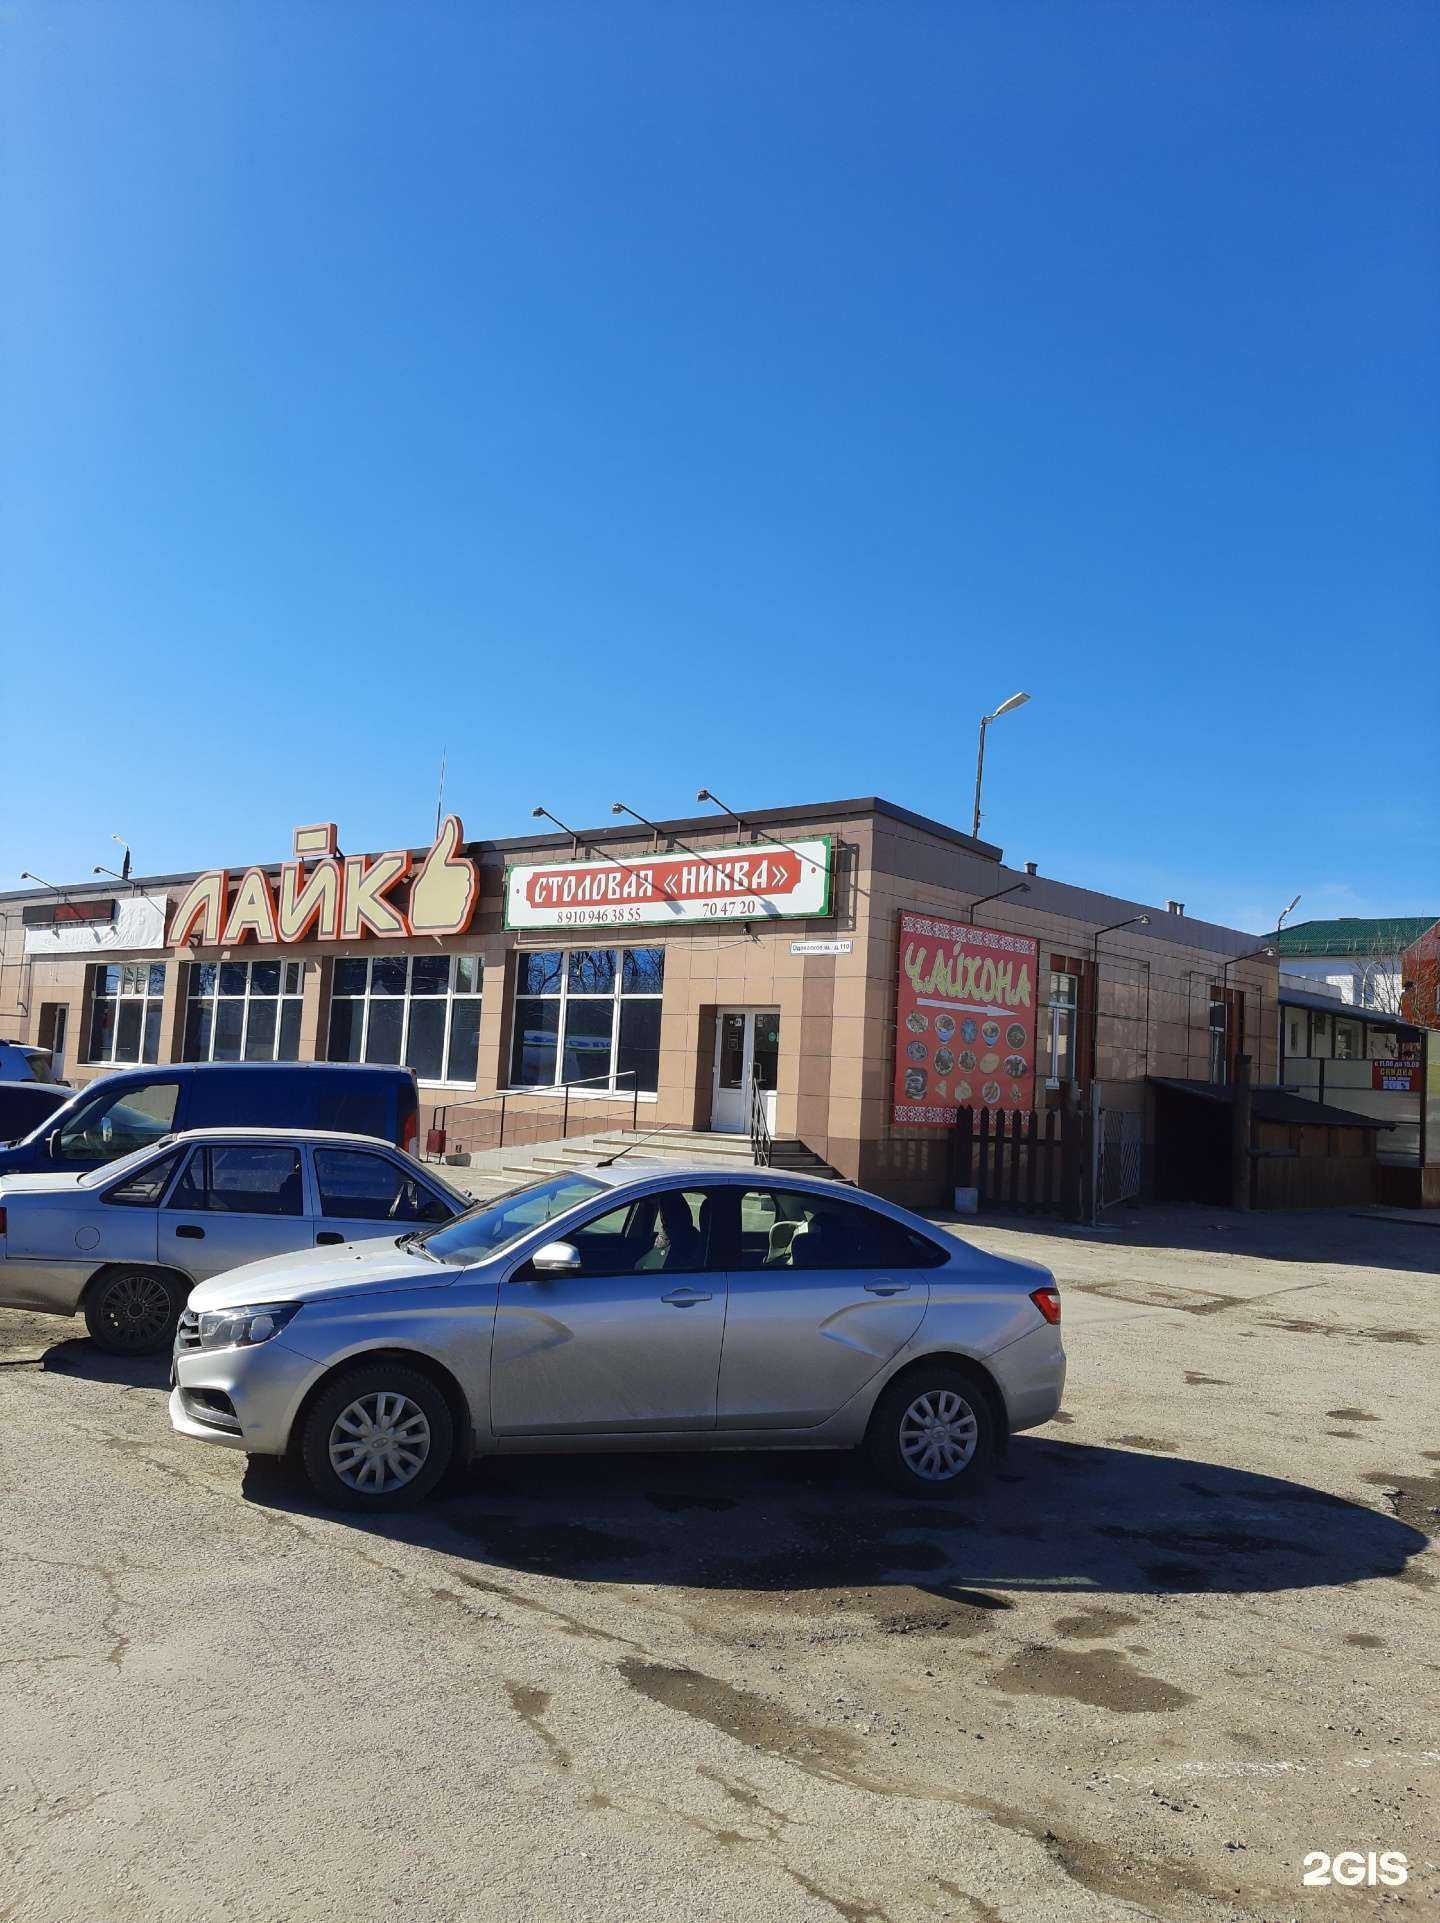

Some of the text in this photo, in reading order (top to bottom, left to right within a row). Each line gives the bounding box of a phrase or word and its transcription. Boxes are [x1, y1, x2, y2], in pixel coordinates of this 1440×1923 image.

[166, 824, 412, 947] ЛАЙК
[534, 859, 788, 903] СТОЛОВАЯ «НИКВА»
[565, 912, 586, 923] 910
[588, 910, 608, 923] 946
[611, 909, 625, 922] 38
[628, 907, 641, 921] 55
[702, 900, 756, 917] 70 47 20
[904, 941, 1031, 1008] ЧАЙХОНА
